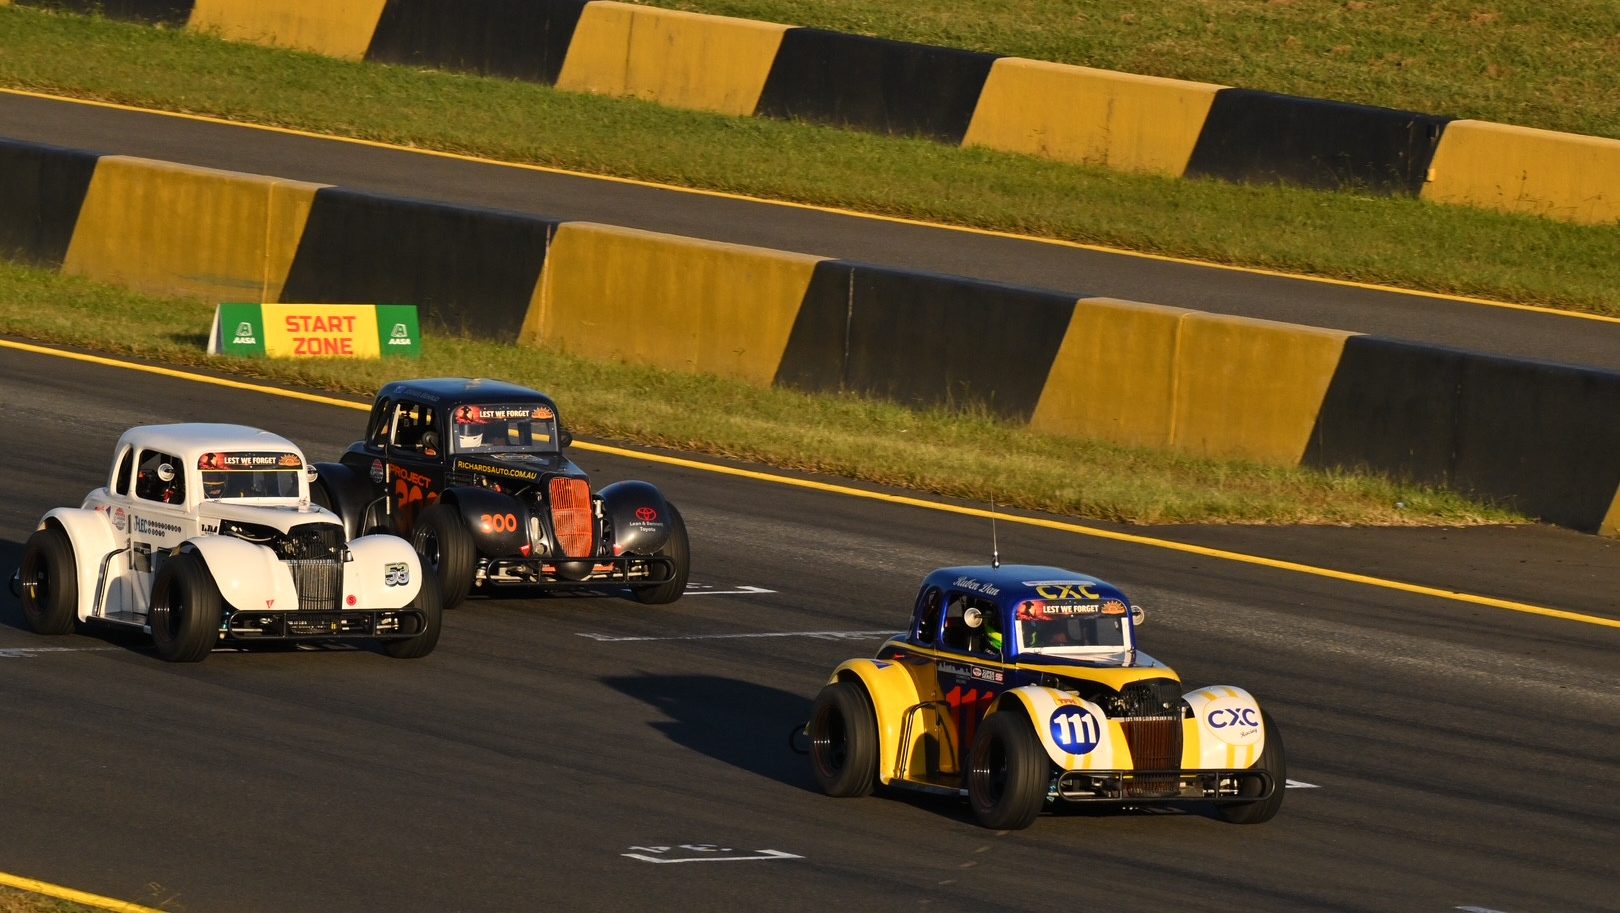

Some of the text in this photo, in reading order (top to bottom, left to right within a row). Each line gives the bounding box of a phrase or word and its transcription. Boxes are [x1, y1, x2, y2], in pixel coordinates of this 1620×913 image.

[286, 316, 356, 332] START
[294, 338, 353, 355] ZONE
[506, 410, 530, 418] FORGET
[224, 456, 276, 465] LEST WE FORGET
[389, 463, 432, 488] PROJECT
[458, 461, 537, 480] RICHARDSAUTO.COM.AU
[481, 513, 516, 533] 300
[384, 562, 410, 587] 53
[1036, 585, 1099, 600] CXC
[1043, 604, 1099, 613] LEST WE FORGET
[1208, 708, 1258, 728] CXC
[1054, 713, 1096, 744] 111
